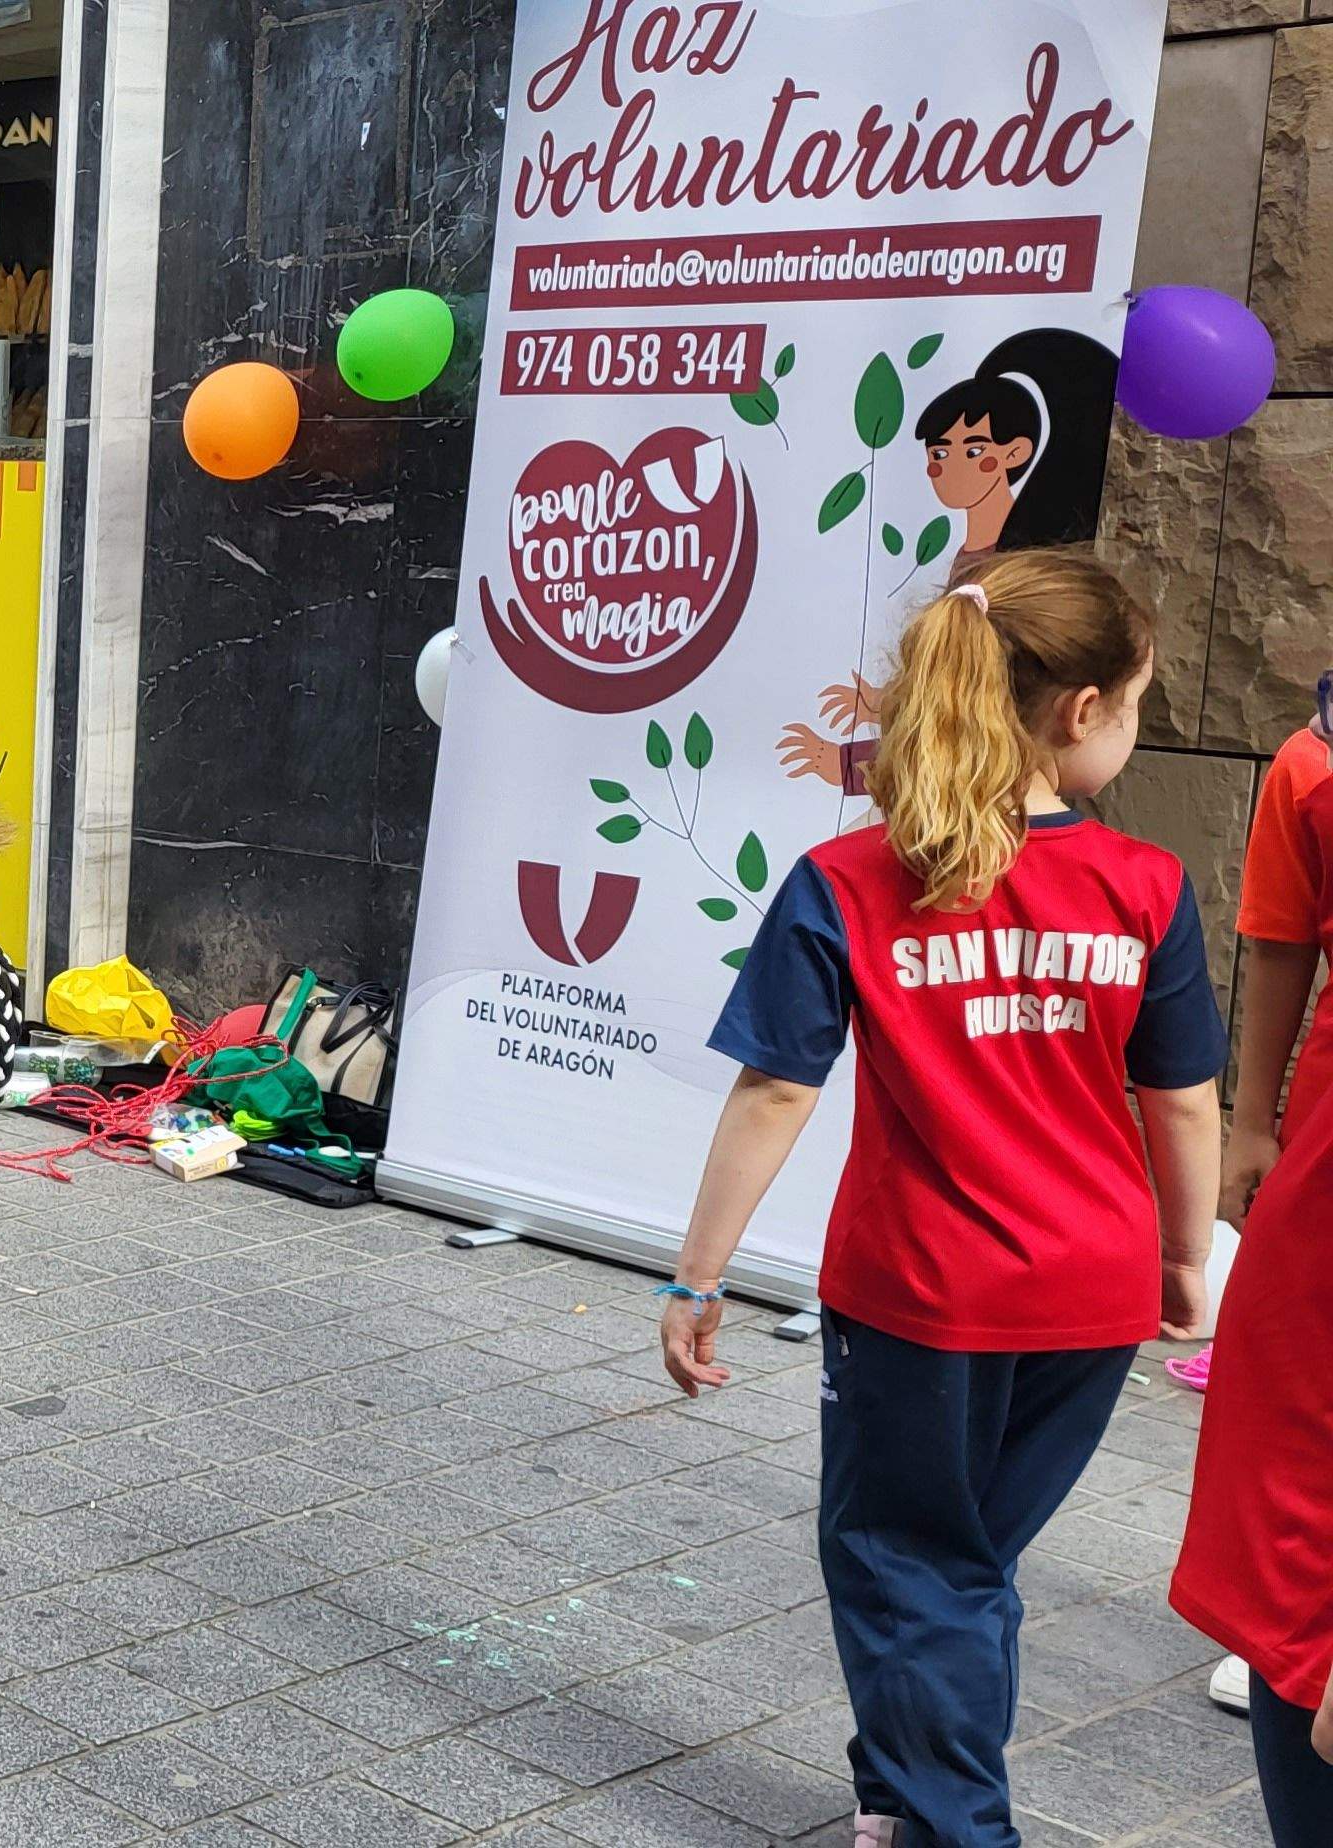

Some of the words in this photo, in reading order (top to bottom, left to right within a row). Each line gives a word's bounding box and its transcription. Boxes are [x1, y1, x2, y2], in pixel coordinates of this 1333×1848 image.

[527, 0, 757, 112] Haz
[514, 42, 1134, 219] voluntariado
[529, 238, 1067, 293] voluntariado@voluntariadodearagon.org
[516, 336, 573, 387] 974
[587, 333, 662, 386] 058
[673, 331, 747, 386] 344
[511, 469, 641, 550] ponle
[522, 523, 716, 582] corazon,
[544, 581, 586, 603] crea
[562, 592, 698, 657] magia
[892, 929, 986, 988] SAN
[993, 927, 1146, 986] VIATOR
[501, 973, 627, 1016] PLATAFORMA
[964, 992, 1087, 1039] HUESCA
[466, 998, 497, 1023] DEL
[503, 1005, 658, 1054] VOLUNTARIADO
[498, 1037, 522, 1061] DE
[525, 1043, 615, 1080] ARAGÓN
